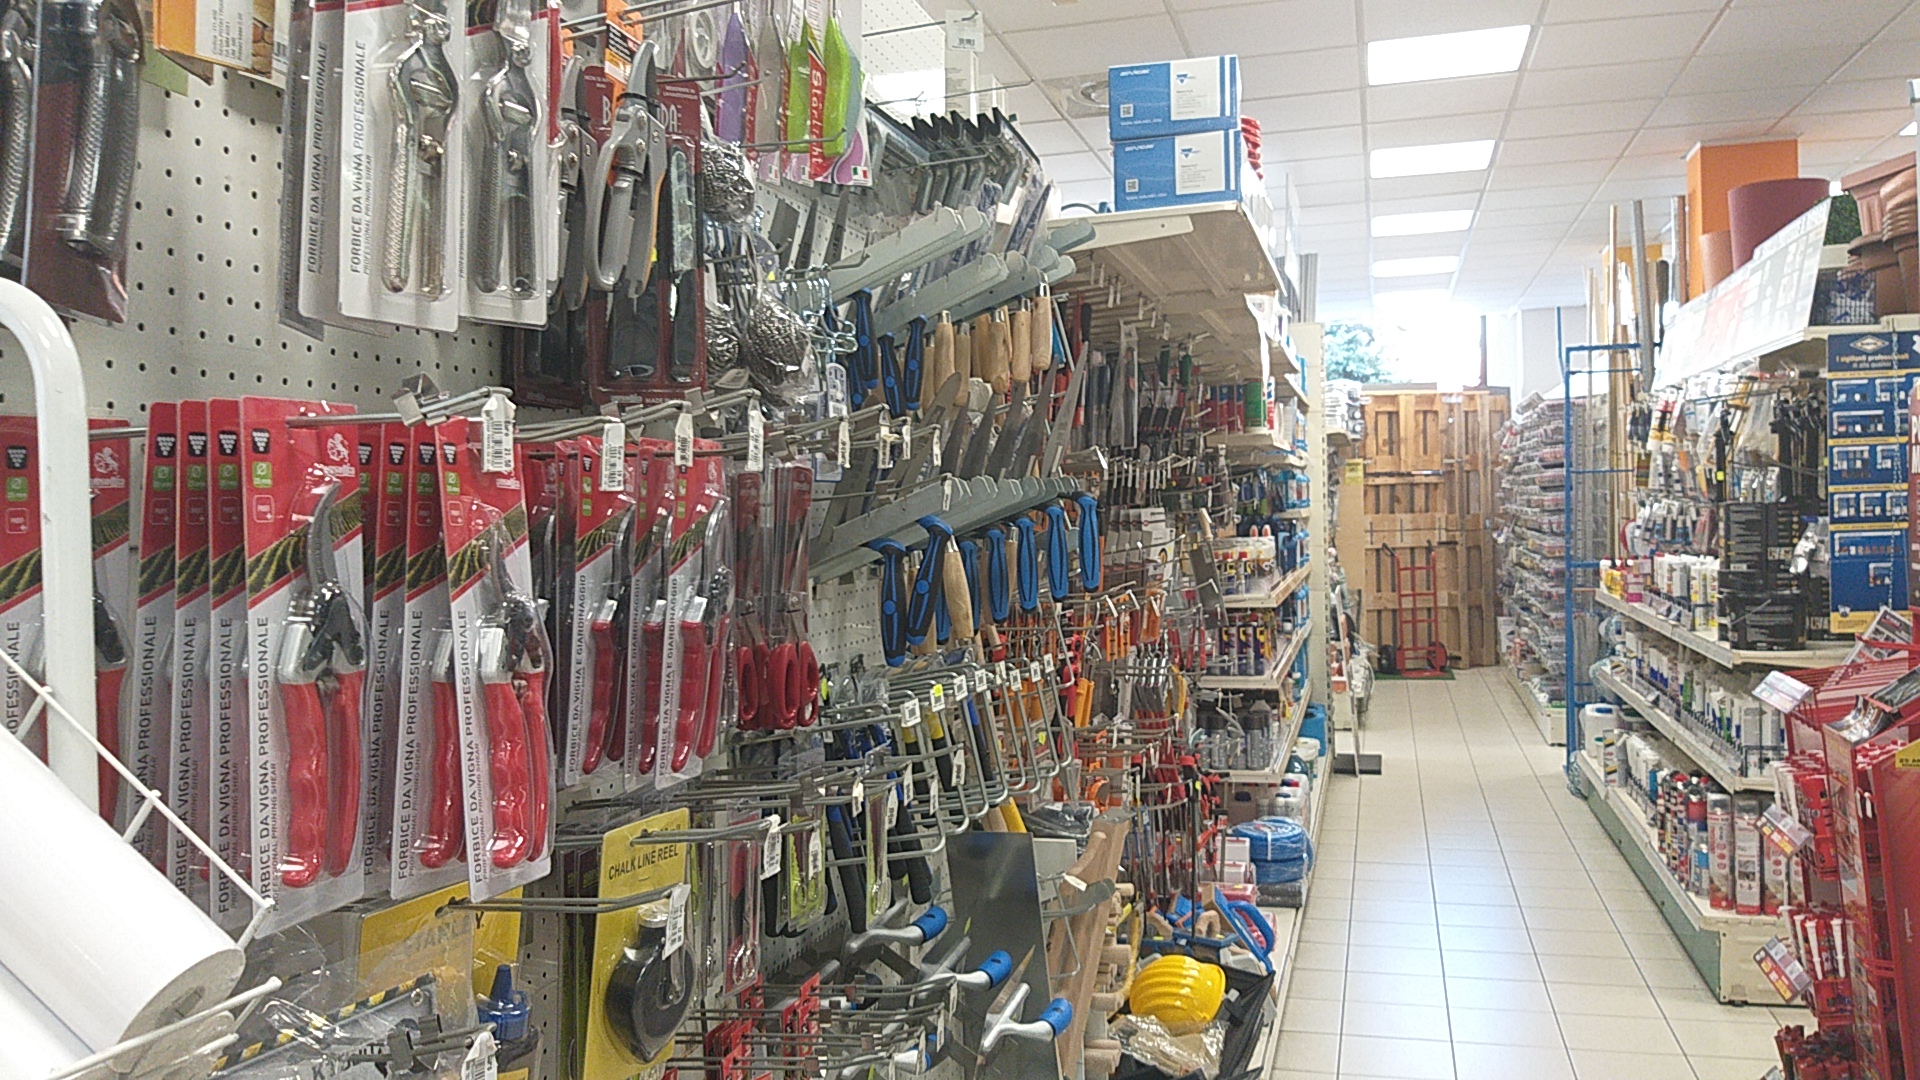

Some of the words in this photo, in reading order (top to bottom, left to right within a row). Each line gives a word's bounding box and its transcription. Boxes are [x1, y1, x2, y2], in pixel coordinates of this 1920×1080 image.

[313, 41, 327, 150] PROFESSIONALE
[353, 40, 366, 150] PROFESSIONALE
[311, 153, 322, 192] VIGNA
[352, 152, 363, 192] VIGNA
[310, 196, 320, 214] DA
[352, 196, 362, 214] DA
[307, 217, 318, 273] FORBICE
[350, 217, 362, 273] FORBICE
[576, 574, 586, 656] GIARDINAGGIO
[664, 671, 672, 706] VIGNA
[668, 578, 678, 660] GIARDINAGGIO
[138, 616, 157, 752] PROFESSIONALE
[180, 617, 196, 753] PROFESSIONALE
[220, 617, 233, 756] PROFESSIONALE
[258, 616, 269, 756] PROFESSIONALE
[373, 610, 390, 732] PROFESSIONALE
[406, 610, 422, 735] PROFESSIONALE
[458, 610, 475, 736] PROFESSIONALE
[574, 668, 582, 703] VIGNA
[573, 704, 580, 720] DA
[370, 737, 381, 782] VIGNA
[403, 739, 416, 786] VIGNA
[466, 740, 476, 788] VIGNA
[569, 723, 578, 773] FORBICE
[178, 757, 190, 808] VIGNA
[219, 760, 230, 811] VIGNA
[258, 760, 270, 813] VIGNA
[270, 762, 278, 795] SHEAR
[401, 788, 412, 806] DA
[469, 790, 478, 812] DA
[218, 814, 230, 837] DA
[259, 814, 270, 838] DA
[270, 796, 278, 839] PRUNING
[398, 814, 412, 880] FORBICE
[470, 816, 482, 883] FORBICE
[608, 858, 636, 880] CHALK
[638, 850, 656, 870] LINE
[658, 844, 679, 862] REEL
